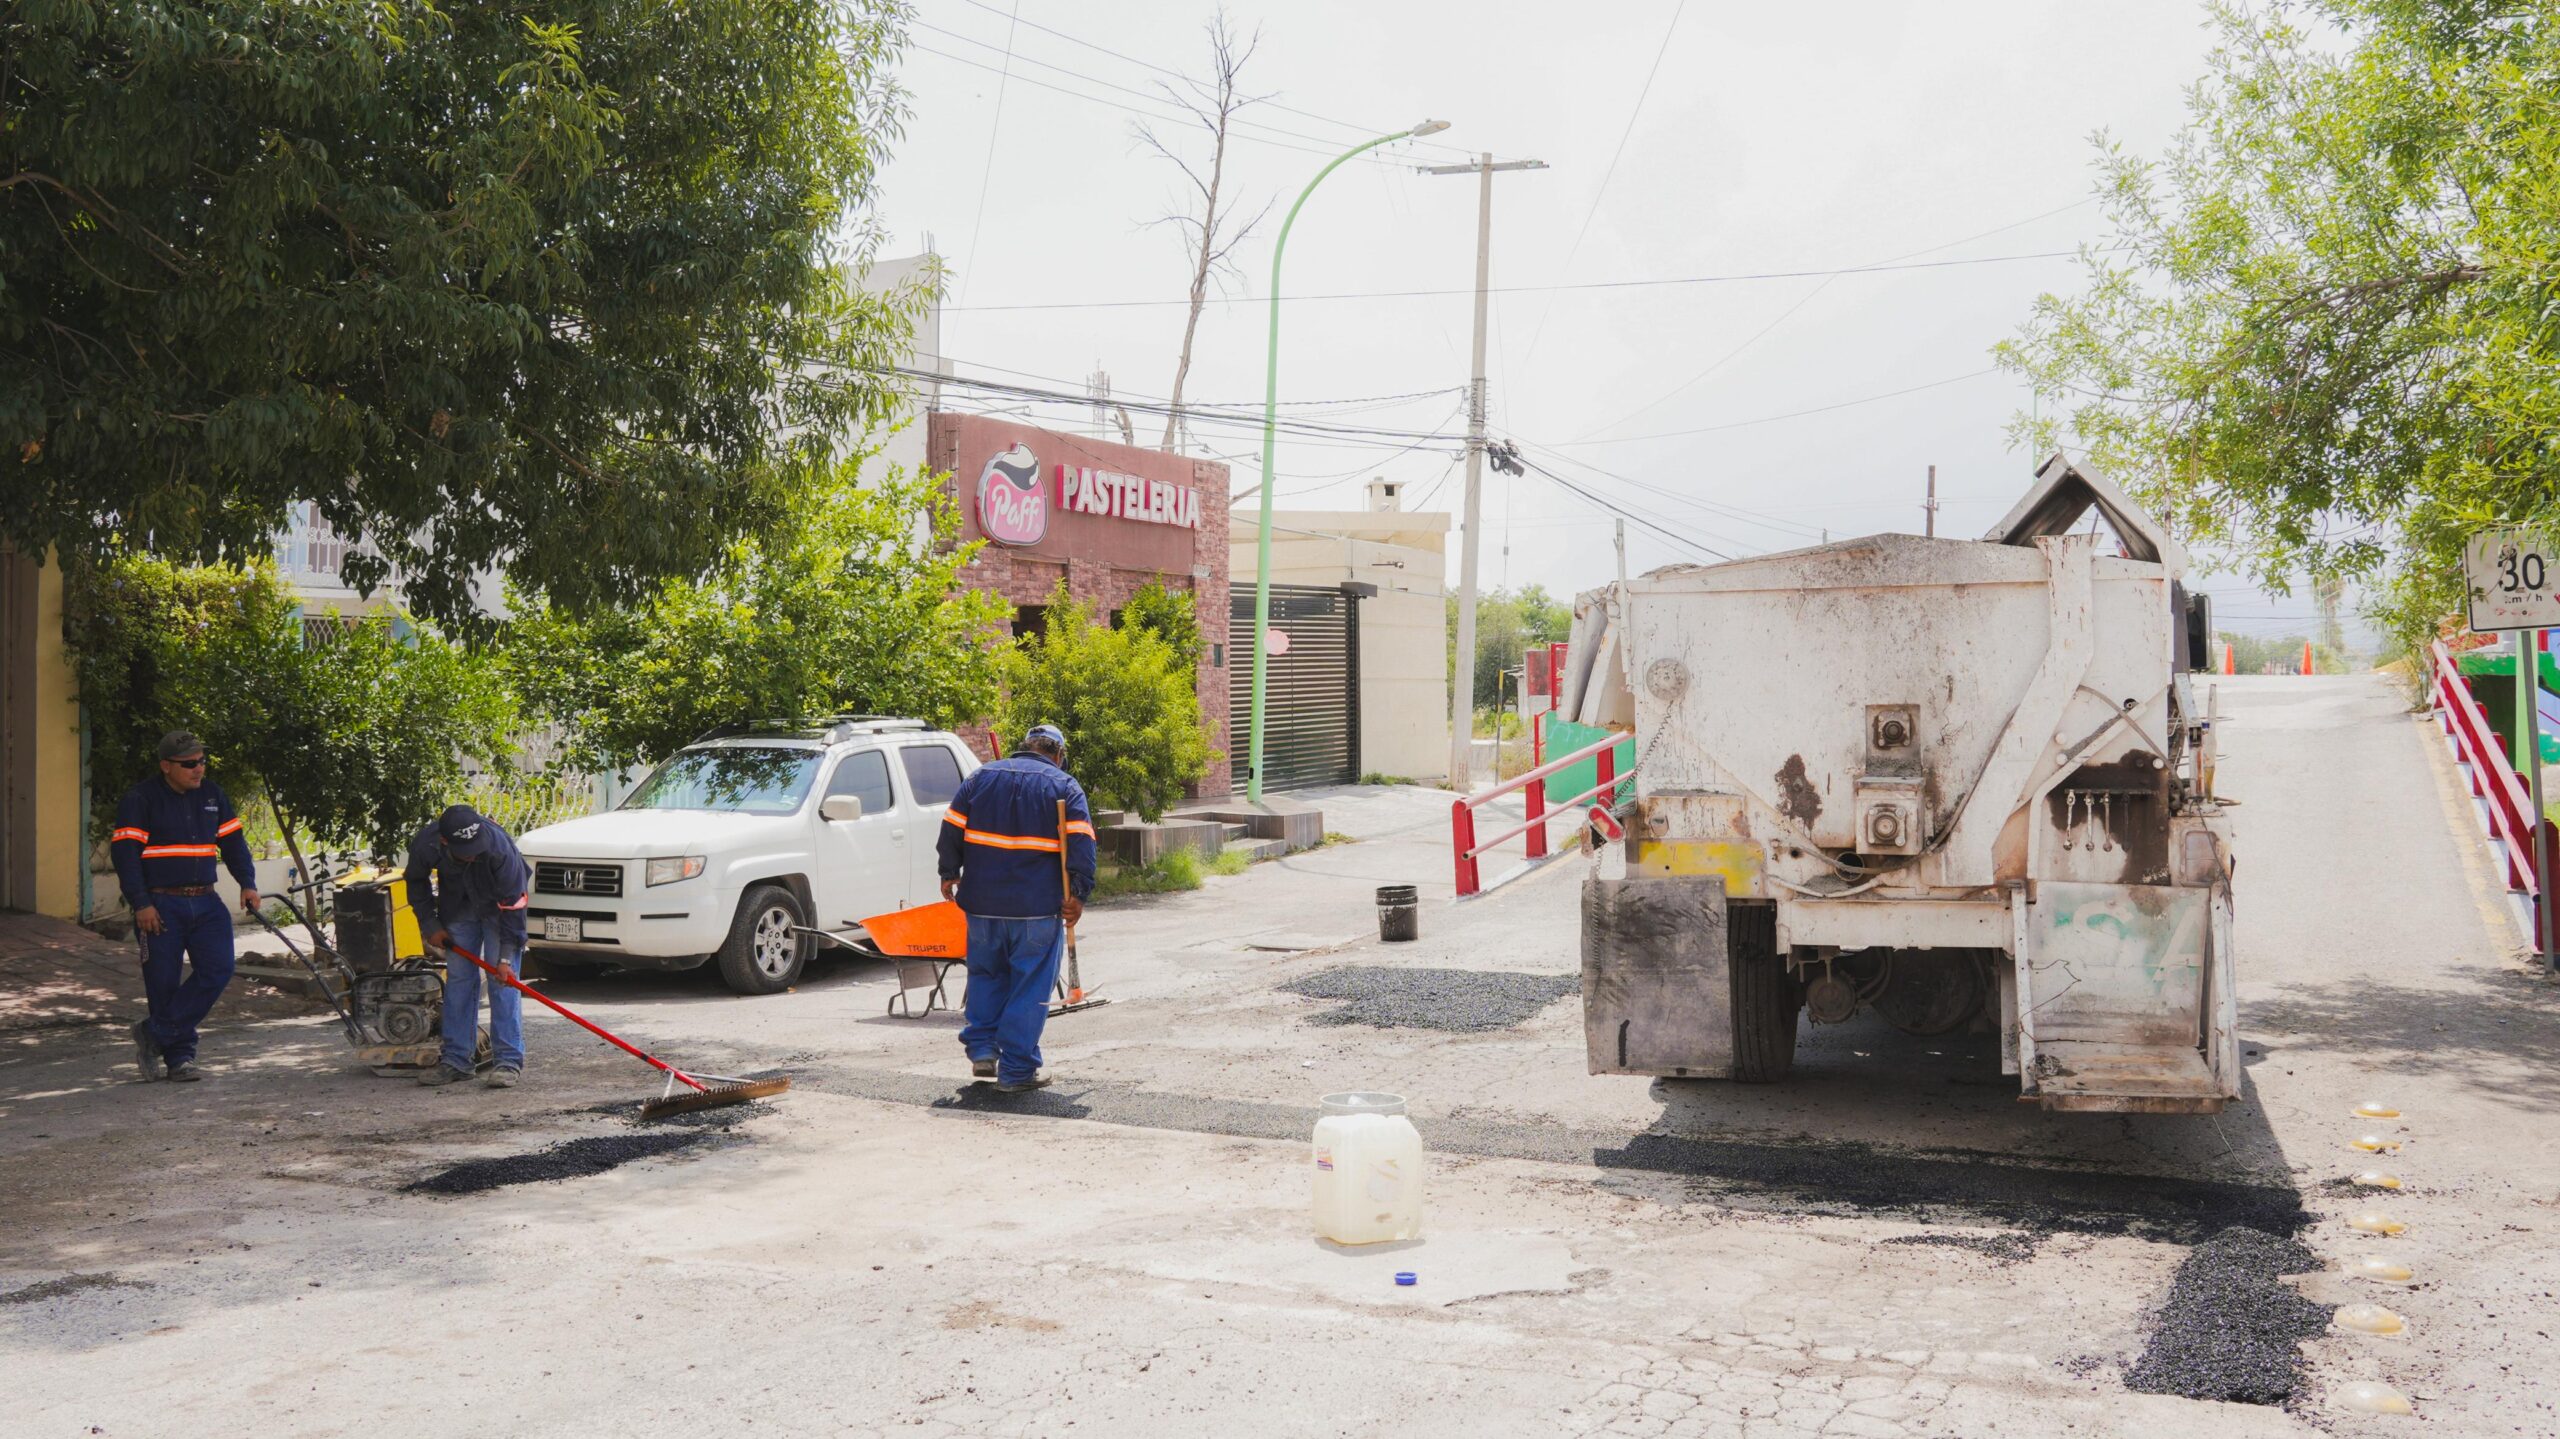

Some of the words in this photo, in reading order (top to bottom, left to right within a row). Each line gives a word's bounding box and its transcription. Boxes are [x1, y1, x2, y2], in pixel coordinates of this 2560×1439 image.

[1062, 463, 1201, 529] PASTELERIA
[2497, 547, 2545, 592] 30
[906, 944, 947, 953] TRUPER
